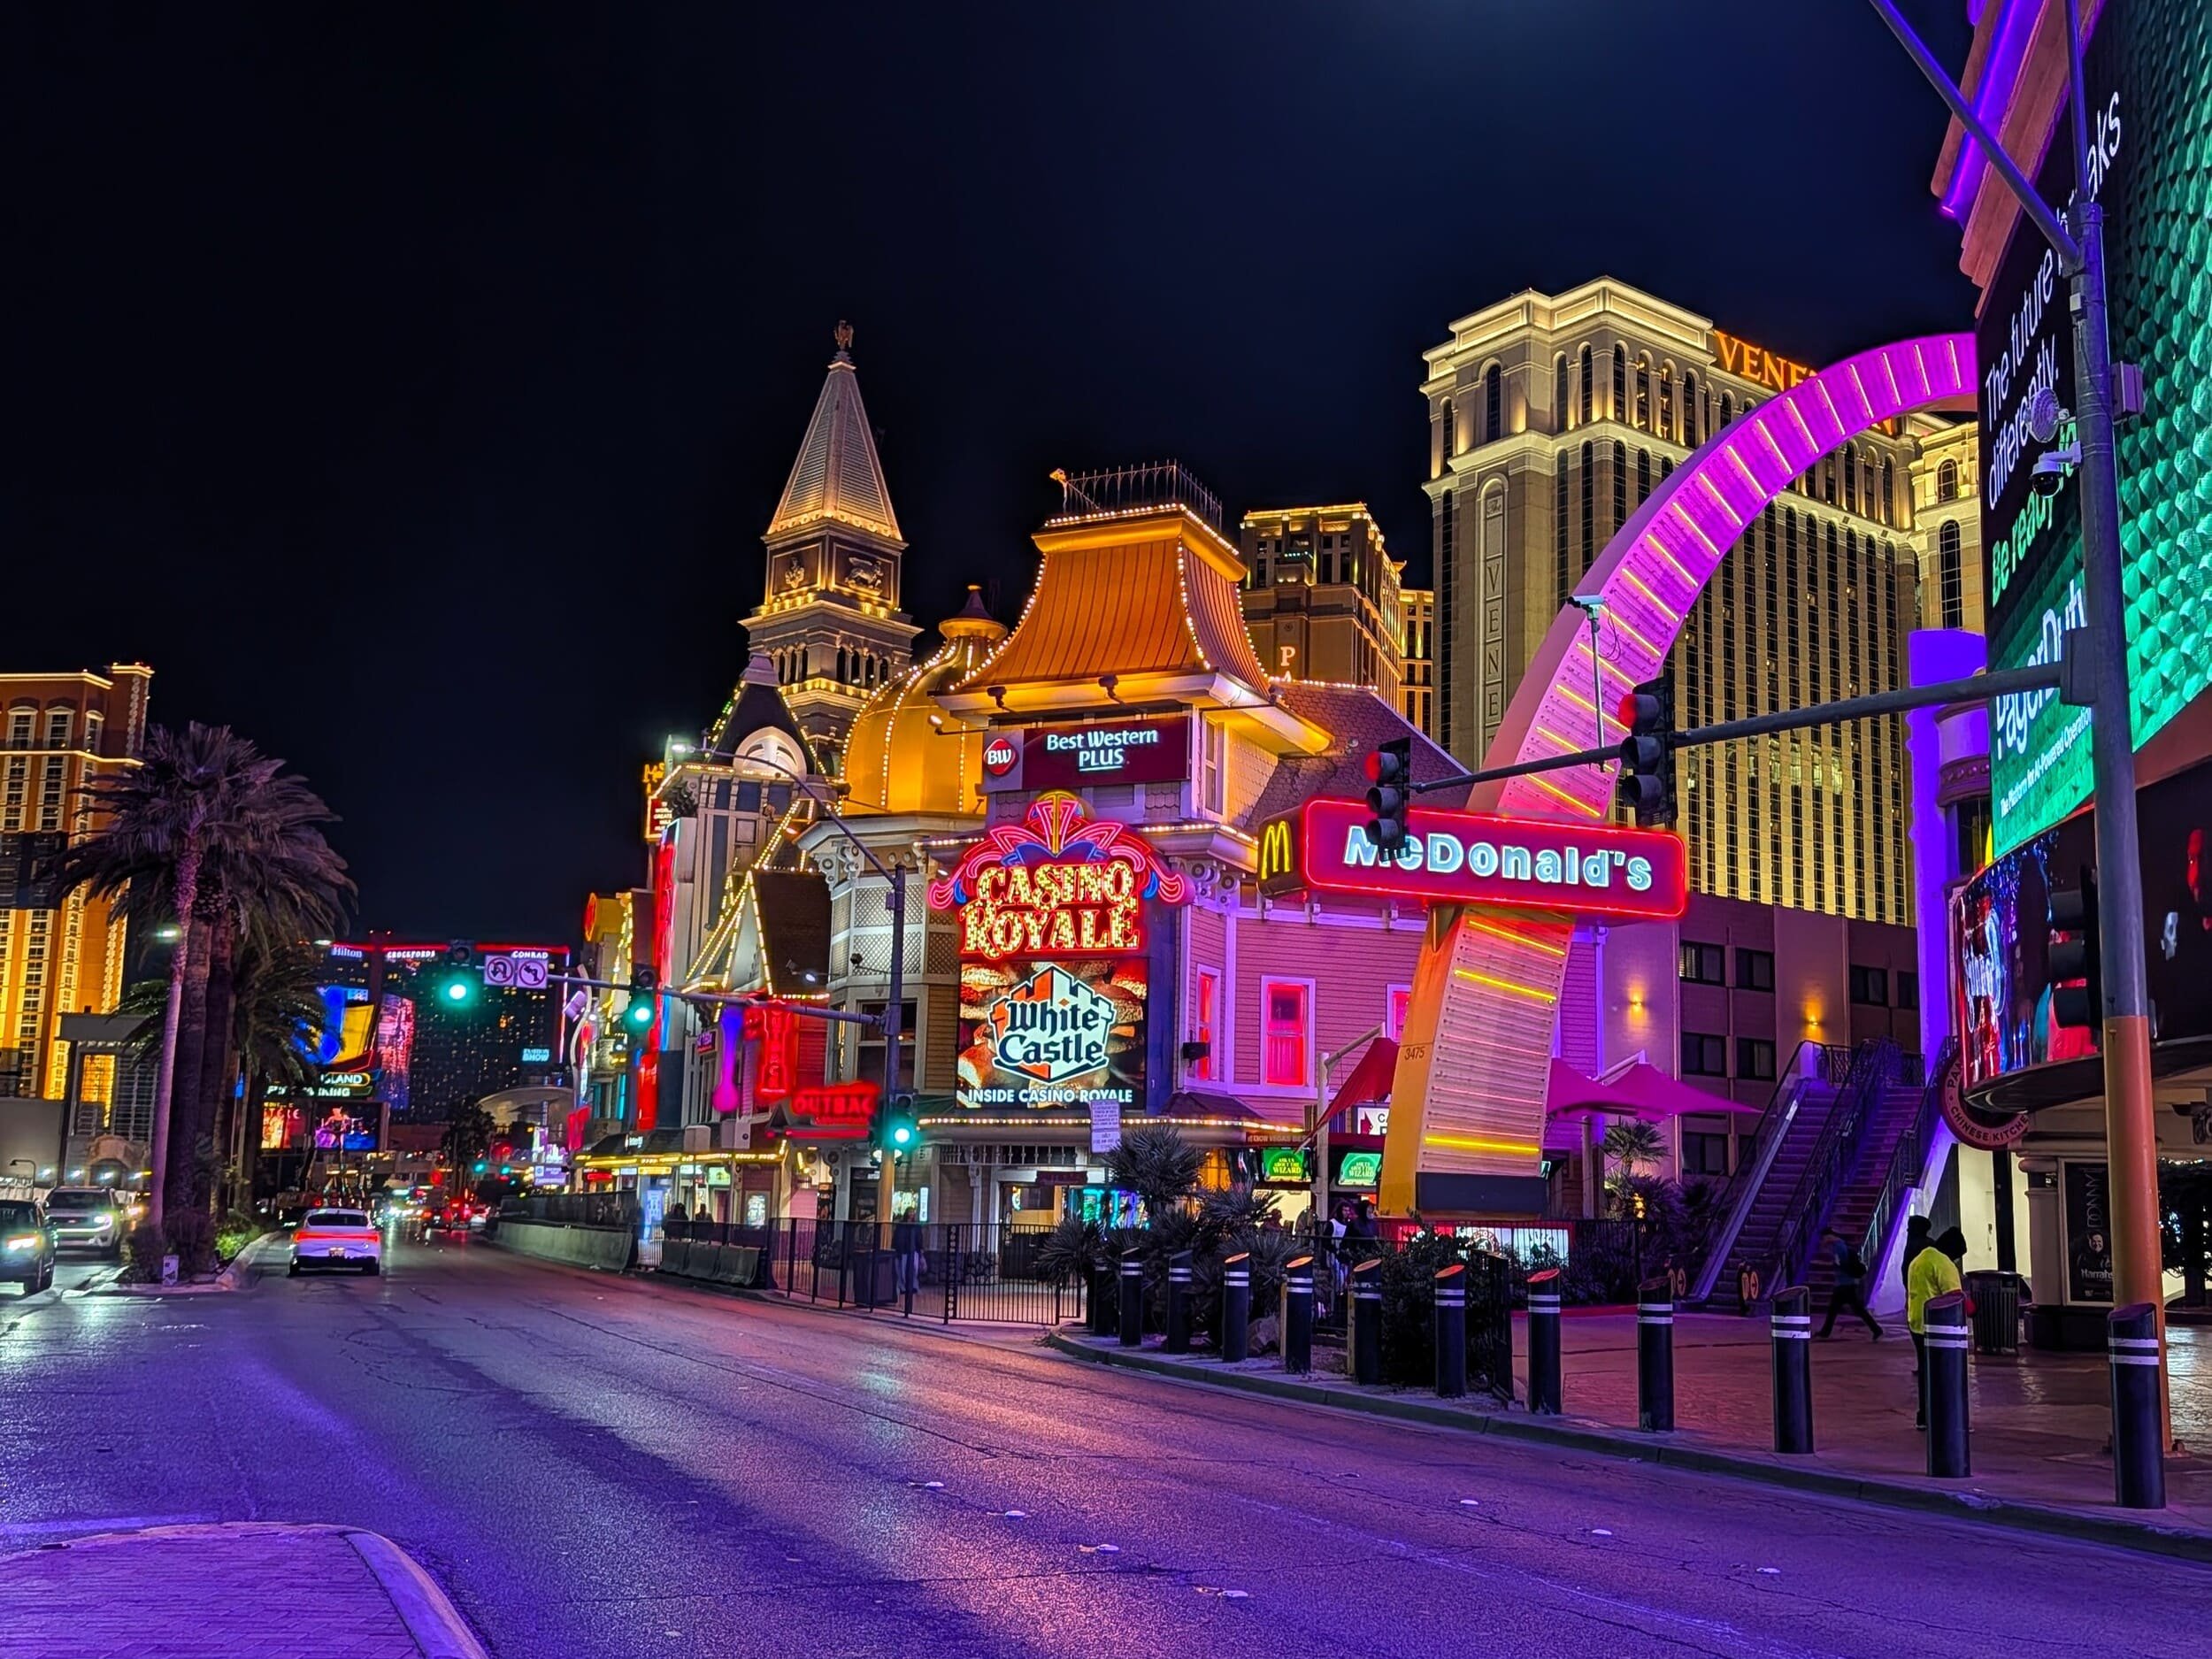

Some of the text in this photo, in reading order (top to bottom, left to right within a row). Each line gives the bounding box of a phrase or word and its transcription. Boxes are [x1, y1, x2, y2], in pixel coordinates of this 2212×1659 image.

[1985, 351, 2009, 433] The
[2011, 248, 2054, 377] future
[1993, 539, 2010, 609] Be
[1047, 729, 1158, 751] Best Western
[987, 749, 1012, 765] BW
[1079, 748, 1125, 767] PLUS
[1343, 825, 1652, 892] McDonald's
[977, 861, 1133, 911] CASINO
[960, 897, 1140, 960] ROYALE
[331, 947, 363, 958] Hilton
[511, 950, 549, 959] CONRAD
[1006, 1001, 1100, 1037] White
[998, 1033, 1103, 1064] Castle
[1404, 1046, 1425, 1061] 3475
[969, 1088, 1133, 1102] INSIDE CASINO ROYALE
[1950, 1106, 2030, 1141] CHINESE KITCHE
[1348, 1169, 1374, 1178] WIZARD
